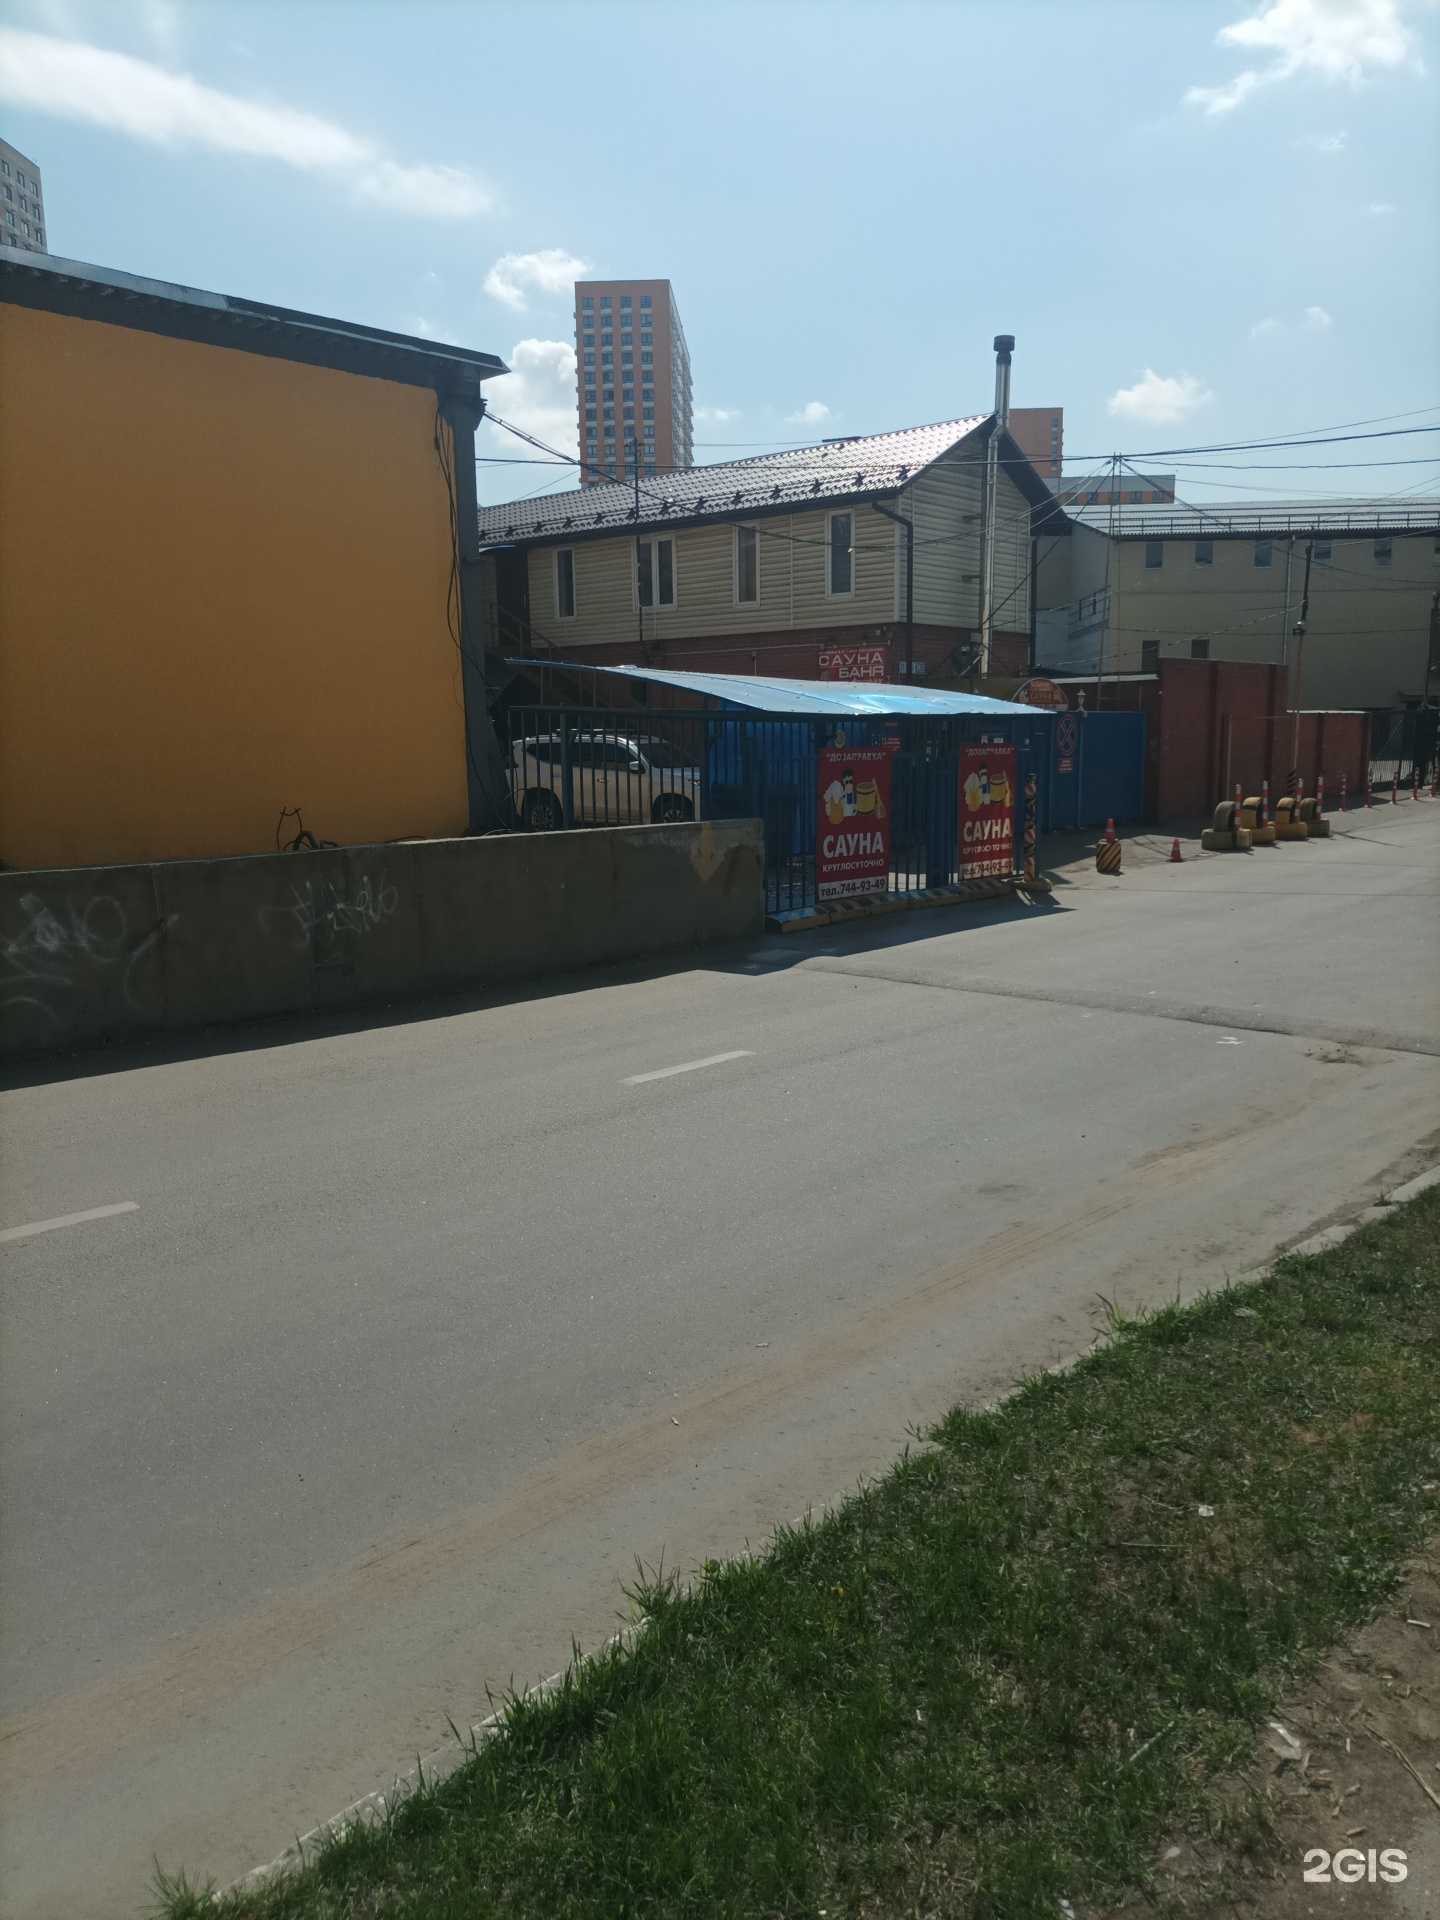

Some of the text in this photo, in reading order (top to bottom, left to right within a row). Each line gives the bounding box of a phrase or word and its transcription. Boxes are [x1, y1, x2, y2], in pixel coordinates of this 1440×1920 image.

[818, 652, 884, 666] САУНА
[839, 665, 885, 678] БАНЯ
[962, 817, 1012, 842] САУНА
[822, 831, 885, 859] САУНА
[822, 858, 885, 873] КРУГЛОСУТОЧНО
